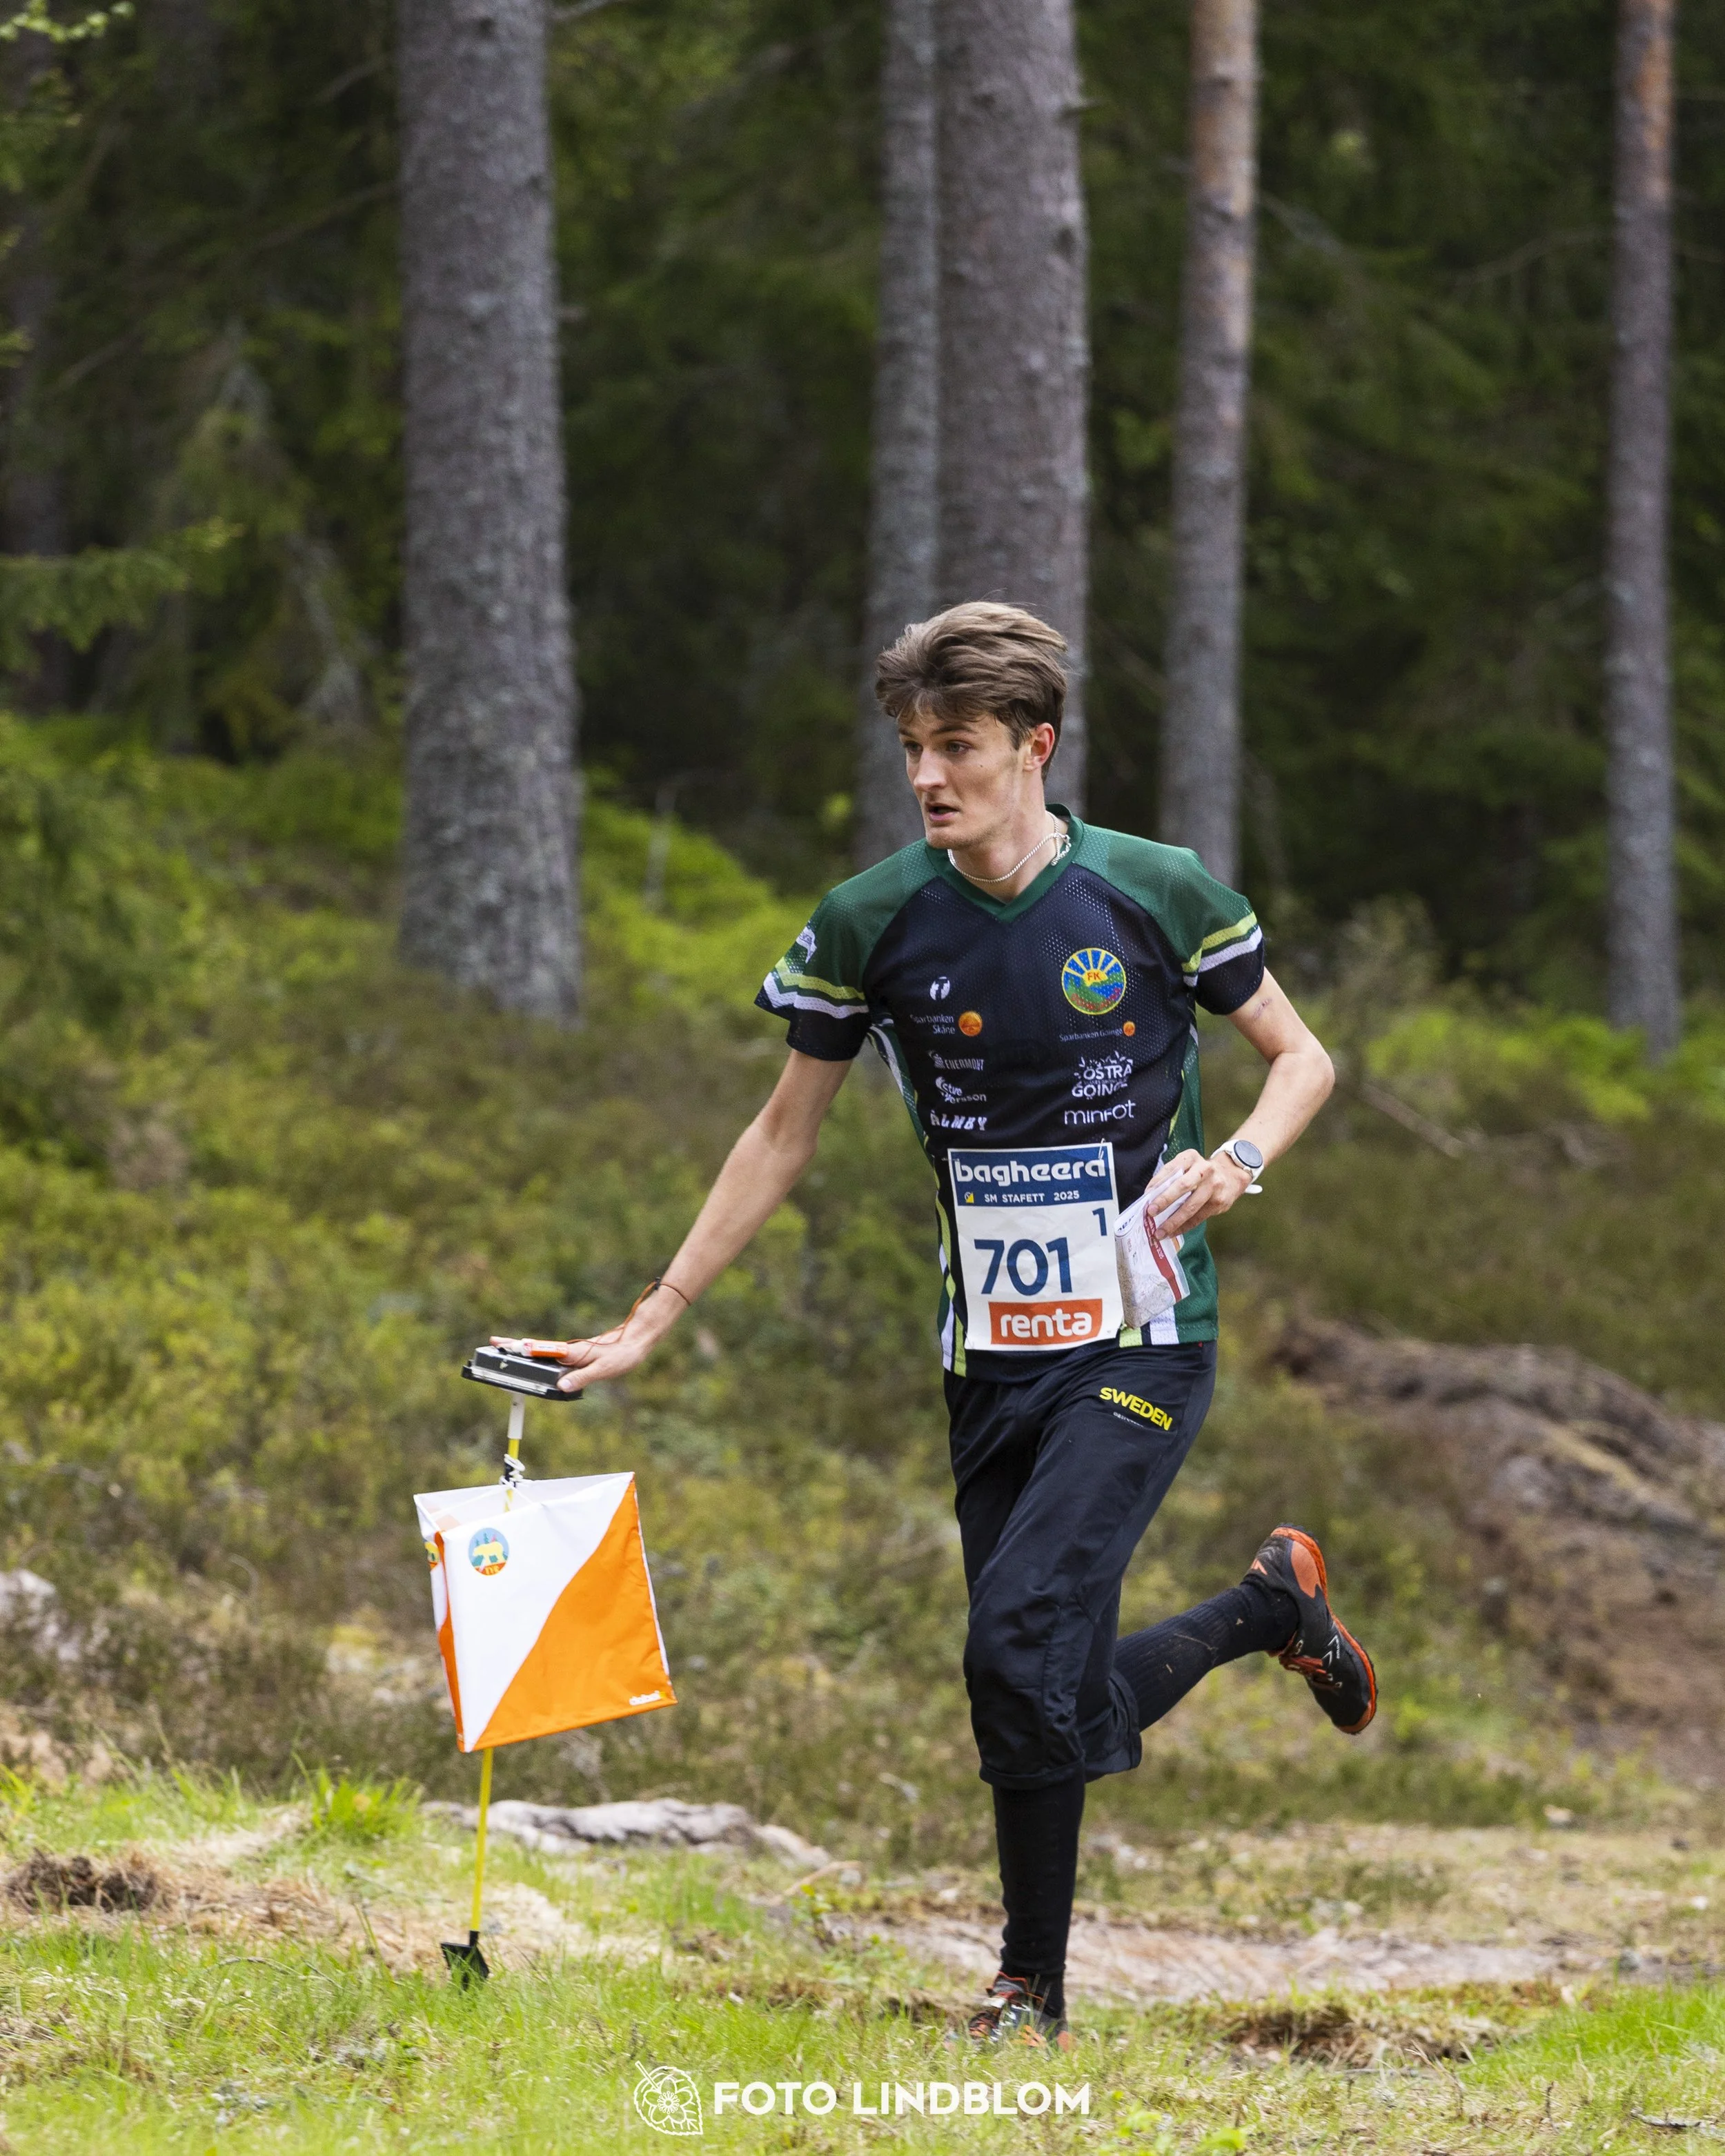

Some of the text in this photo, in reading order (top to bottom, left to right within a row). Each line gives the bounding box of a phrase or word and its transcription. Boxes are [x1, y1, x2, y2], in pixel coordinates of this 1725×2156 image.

[1087, 972, 1101, 980] FK
[954, 1159, 1105, 1187] bagheera
[984, 1191, 1080, 1203] SM STAFETT 2025
[1092, 1207, 1107, 1236] 1
[974, 1237, 1073, 1296] 701
[1000, 1309, 1092, 1338] renta
[1099, 1387, 1173, 1431] SWEDEN
